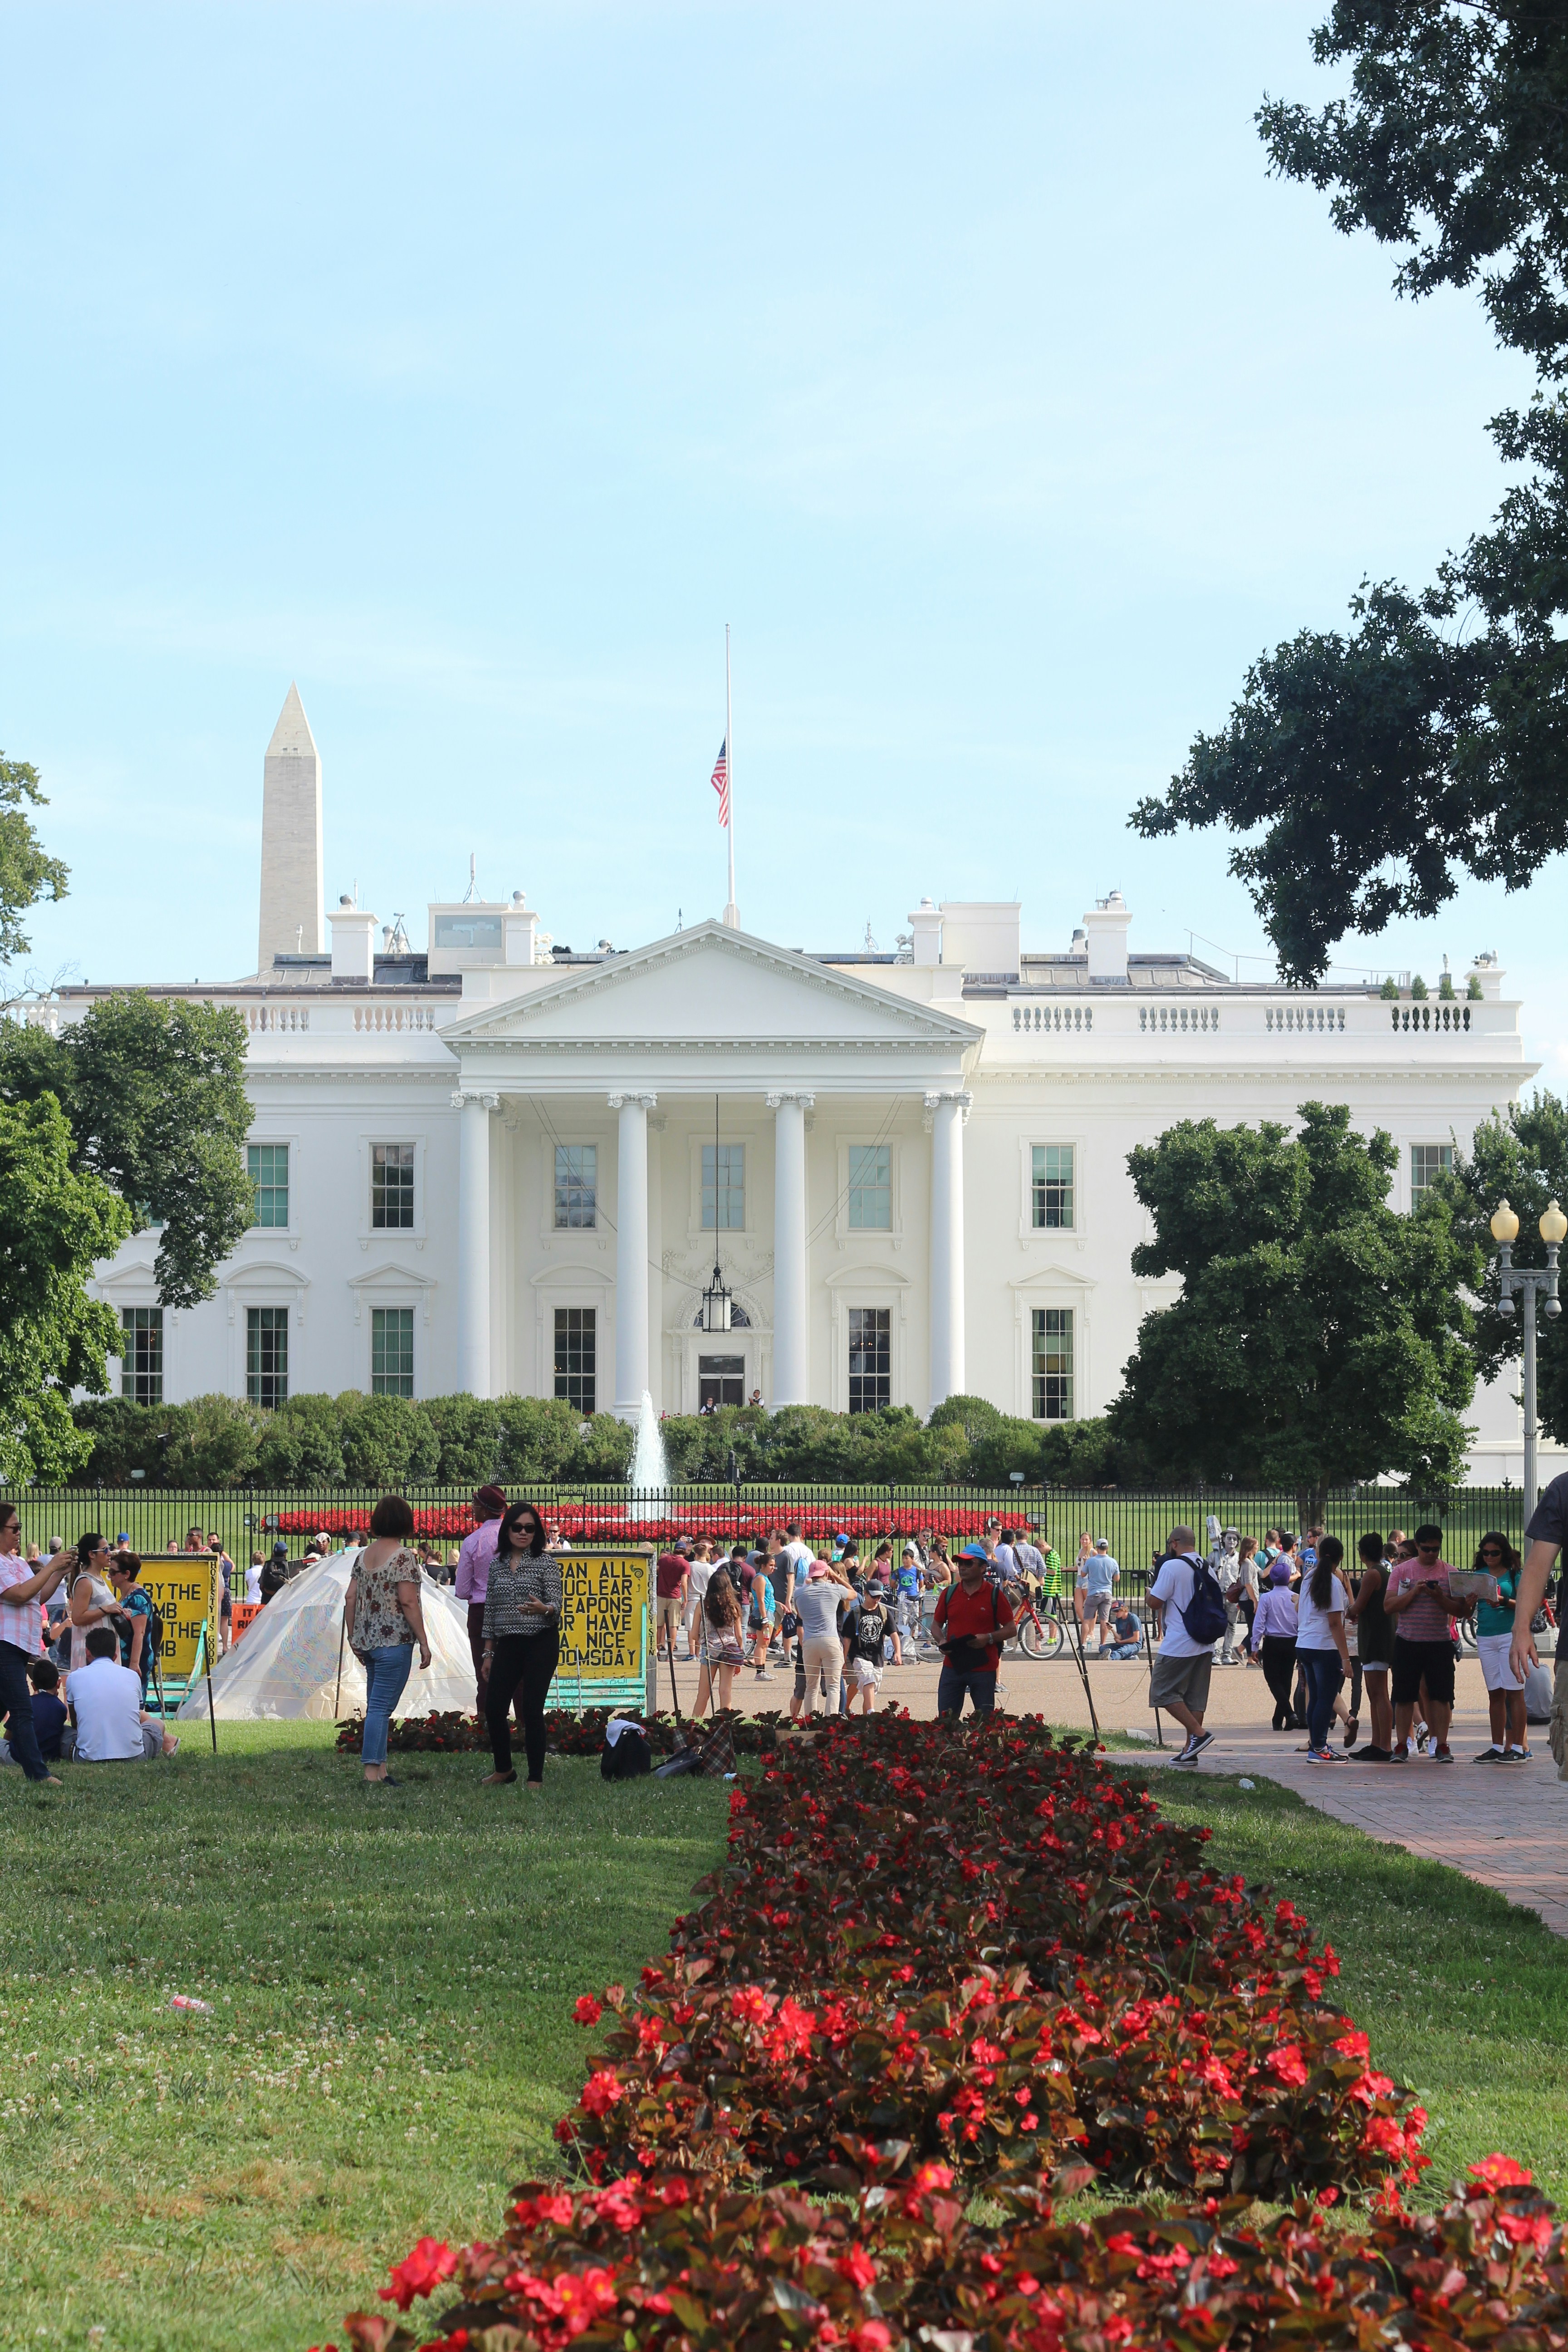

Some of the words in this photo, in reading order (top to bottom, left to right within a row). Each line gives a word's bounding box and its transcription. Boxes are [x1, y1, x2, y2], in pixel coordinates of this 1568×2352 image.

[599, 1562, 632, 1578] ALL
[168, 1583, 201, 1600] THE
[561, 1579, 632, 1596] UCLEAR
[243, 1609, 253, 1617] IT
[561, 1597, 632, 1614] EAPONS
[167, 1622, 200, 1638] THE
[587, 1614, 632, 1631] HAVE
[560, 1632, 569, 1648] A
[587, 1632, 625, 1648] NICE
[558, 1649, 636, 1666] DOOMSDAY
